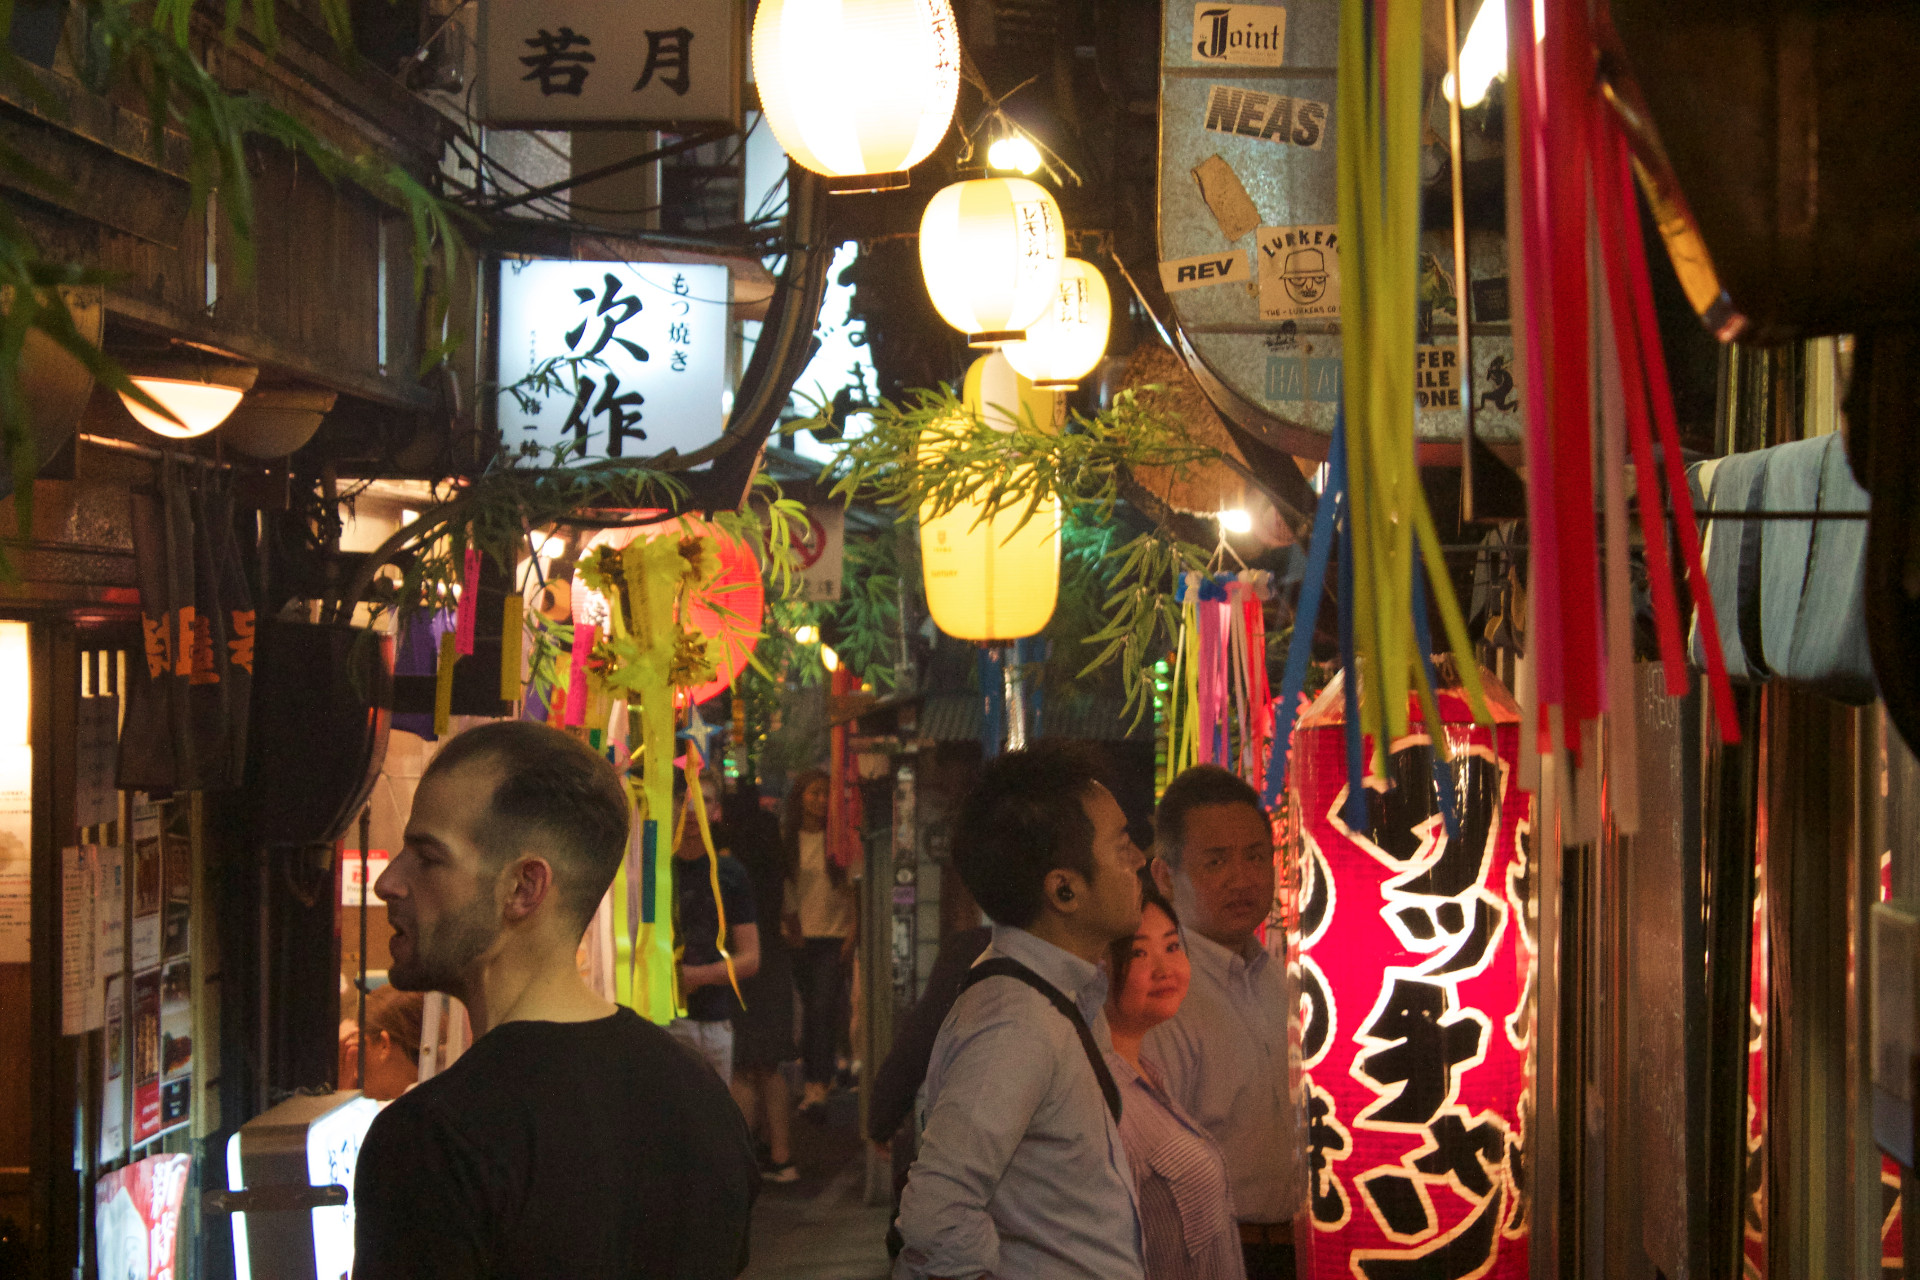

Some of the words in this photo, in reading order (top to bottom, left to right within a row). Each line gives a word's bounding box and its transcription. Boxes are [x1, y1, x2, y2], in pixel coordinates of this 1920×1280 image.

[518, 27, 695, 97] 若月
[1197, 8, 1279, 60] Joint
[1206, 86, 1325, 147] NEAS
[1178, 258, 1233, 283] REV
[668, 273, 691, 373] もつ焼き
[562, 273, 649, 458] 次作
[1416, 351, 1456, 369] FER
[1416, 370, 1450, 388] ILE
